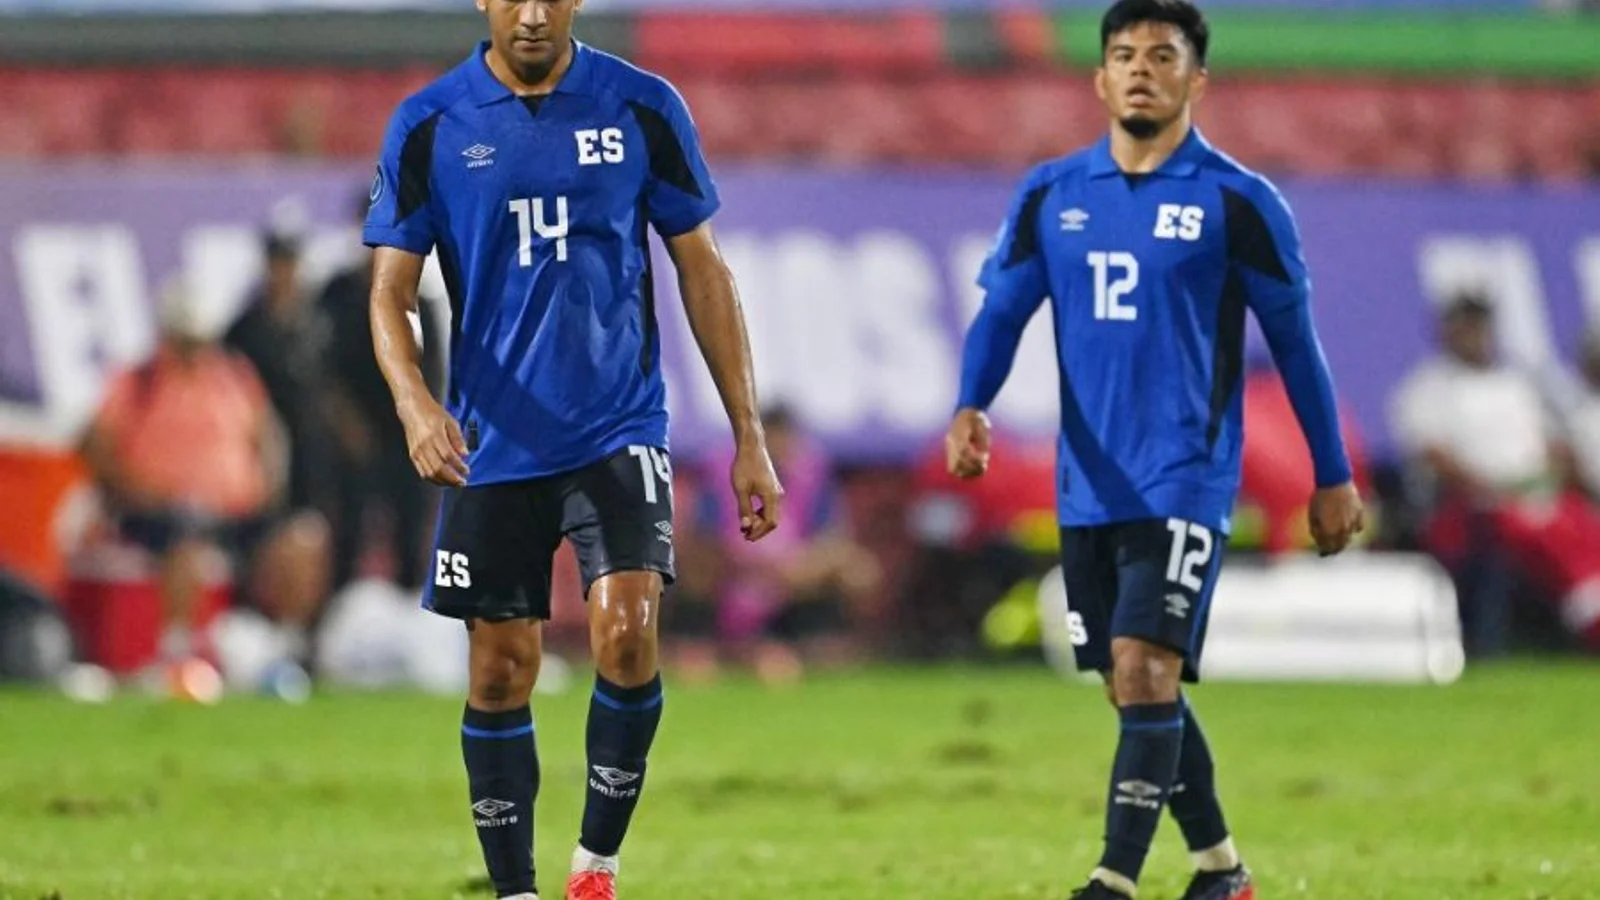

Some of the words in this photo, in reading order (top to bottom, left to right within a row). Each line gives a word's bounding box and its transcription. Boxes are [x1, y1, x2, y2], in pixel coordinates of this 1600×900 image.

[575, 128, 624, 165] ES
[508, 196, 568, 267] 14
[1153, 204, 1204, 241] ES
[1087, 251, 1139, 320] 12
[435, 550, 471, 589] ES
[1166, 517, 1212, 592] 12
